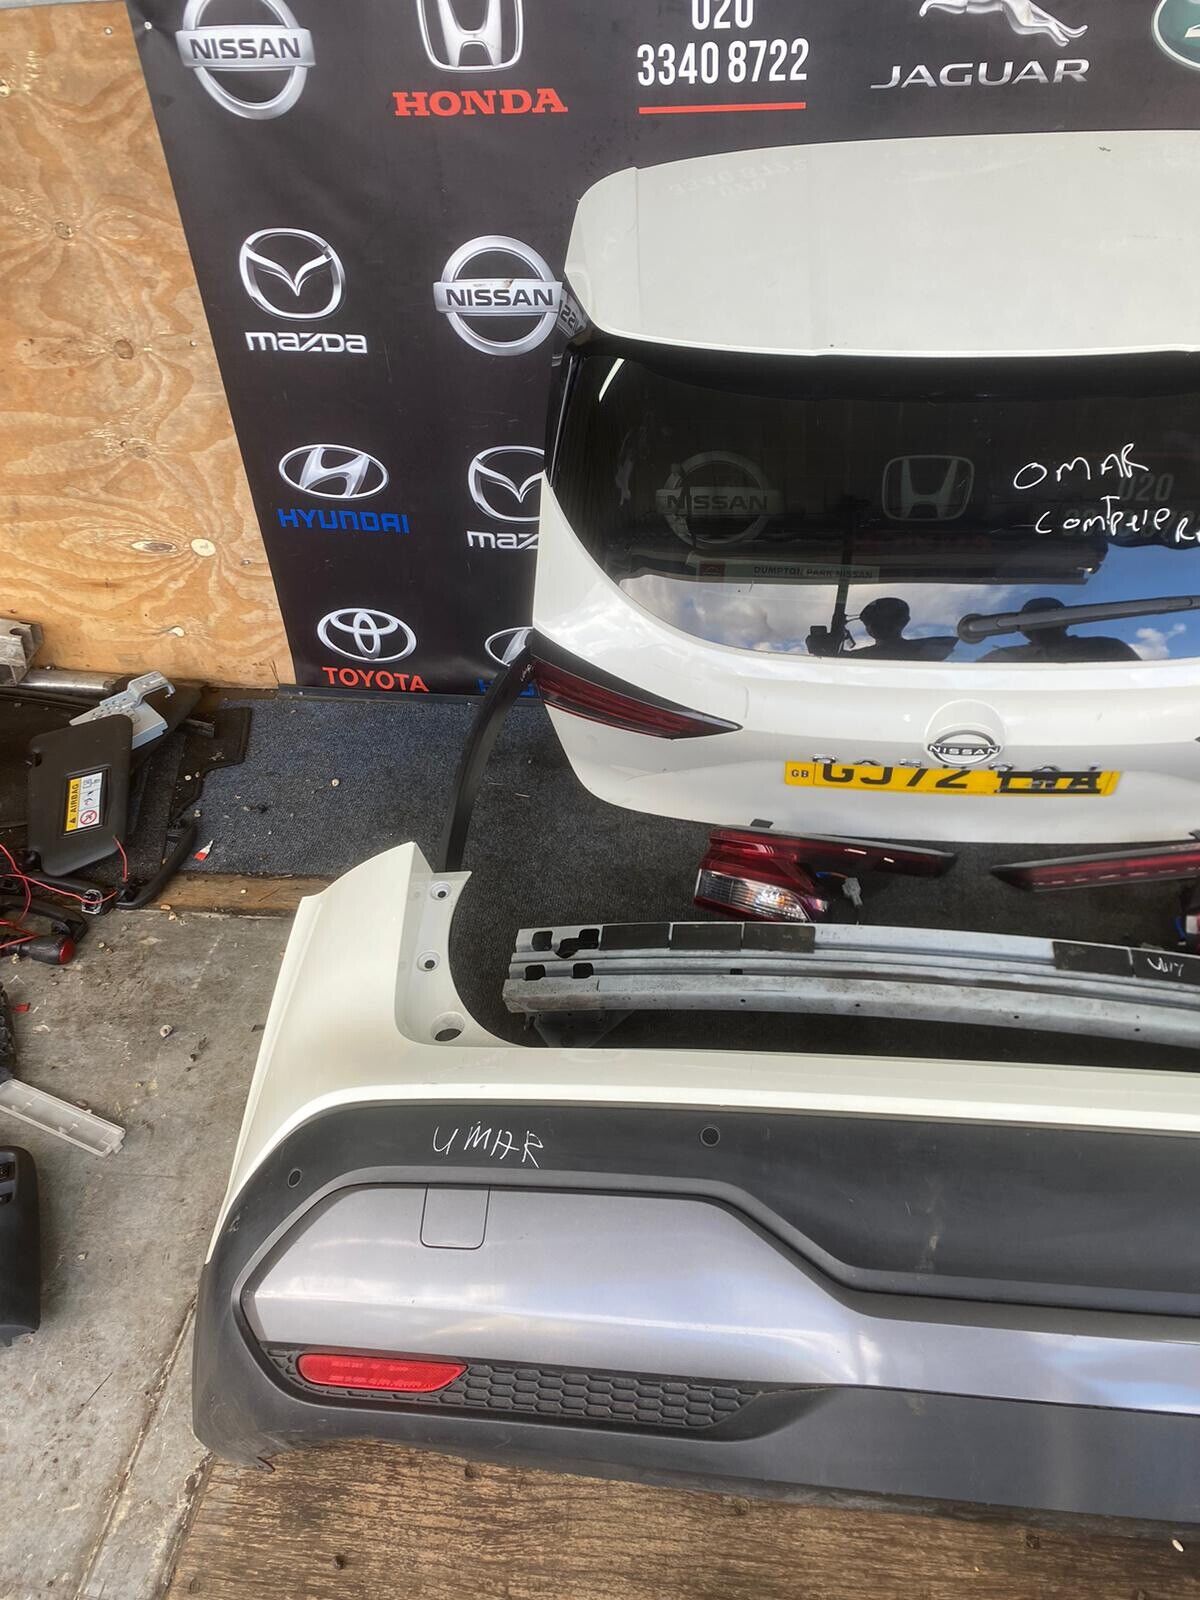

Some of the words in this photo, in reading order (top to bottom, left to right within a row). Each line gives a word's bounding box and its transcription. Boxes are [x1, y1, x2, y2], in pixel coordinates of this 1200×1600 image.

[692, 0, 754, 30] 020
[189, 37, 301, 60] NISSAN
[637, 41, 720, 86] 3340
[727, 37, 809, 83] 8722
[870, 58, 1090, 90] JAGUAR
[392, 88, 568, 117] HONDA
[445, 288, 554, 307] NISSAN
[666, 494, 768, 512] NISSAN
[277, 508, 410, 534] HYUNDAI
[466, 530, 541, 550] maz
[322, 666, 429, 692] TOYOTA
[929, 744, 999, 757] NISSAN
[791, 768, 809, 778] GB
[71, 784, 79, 813] AIRBAG
[432, 1120, 544, 1169] UMAR
